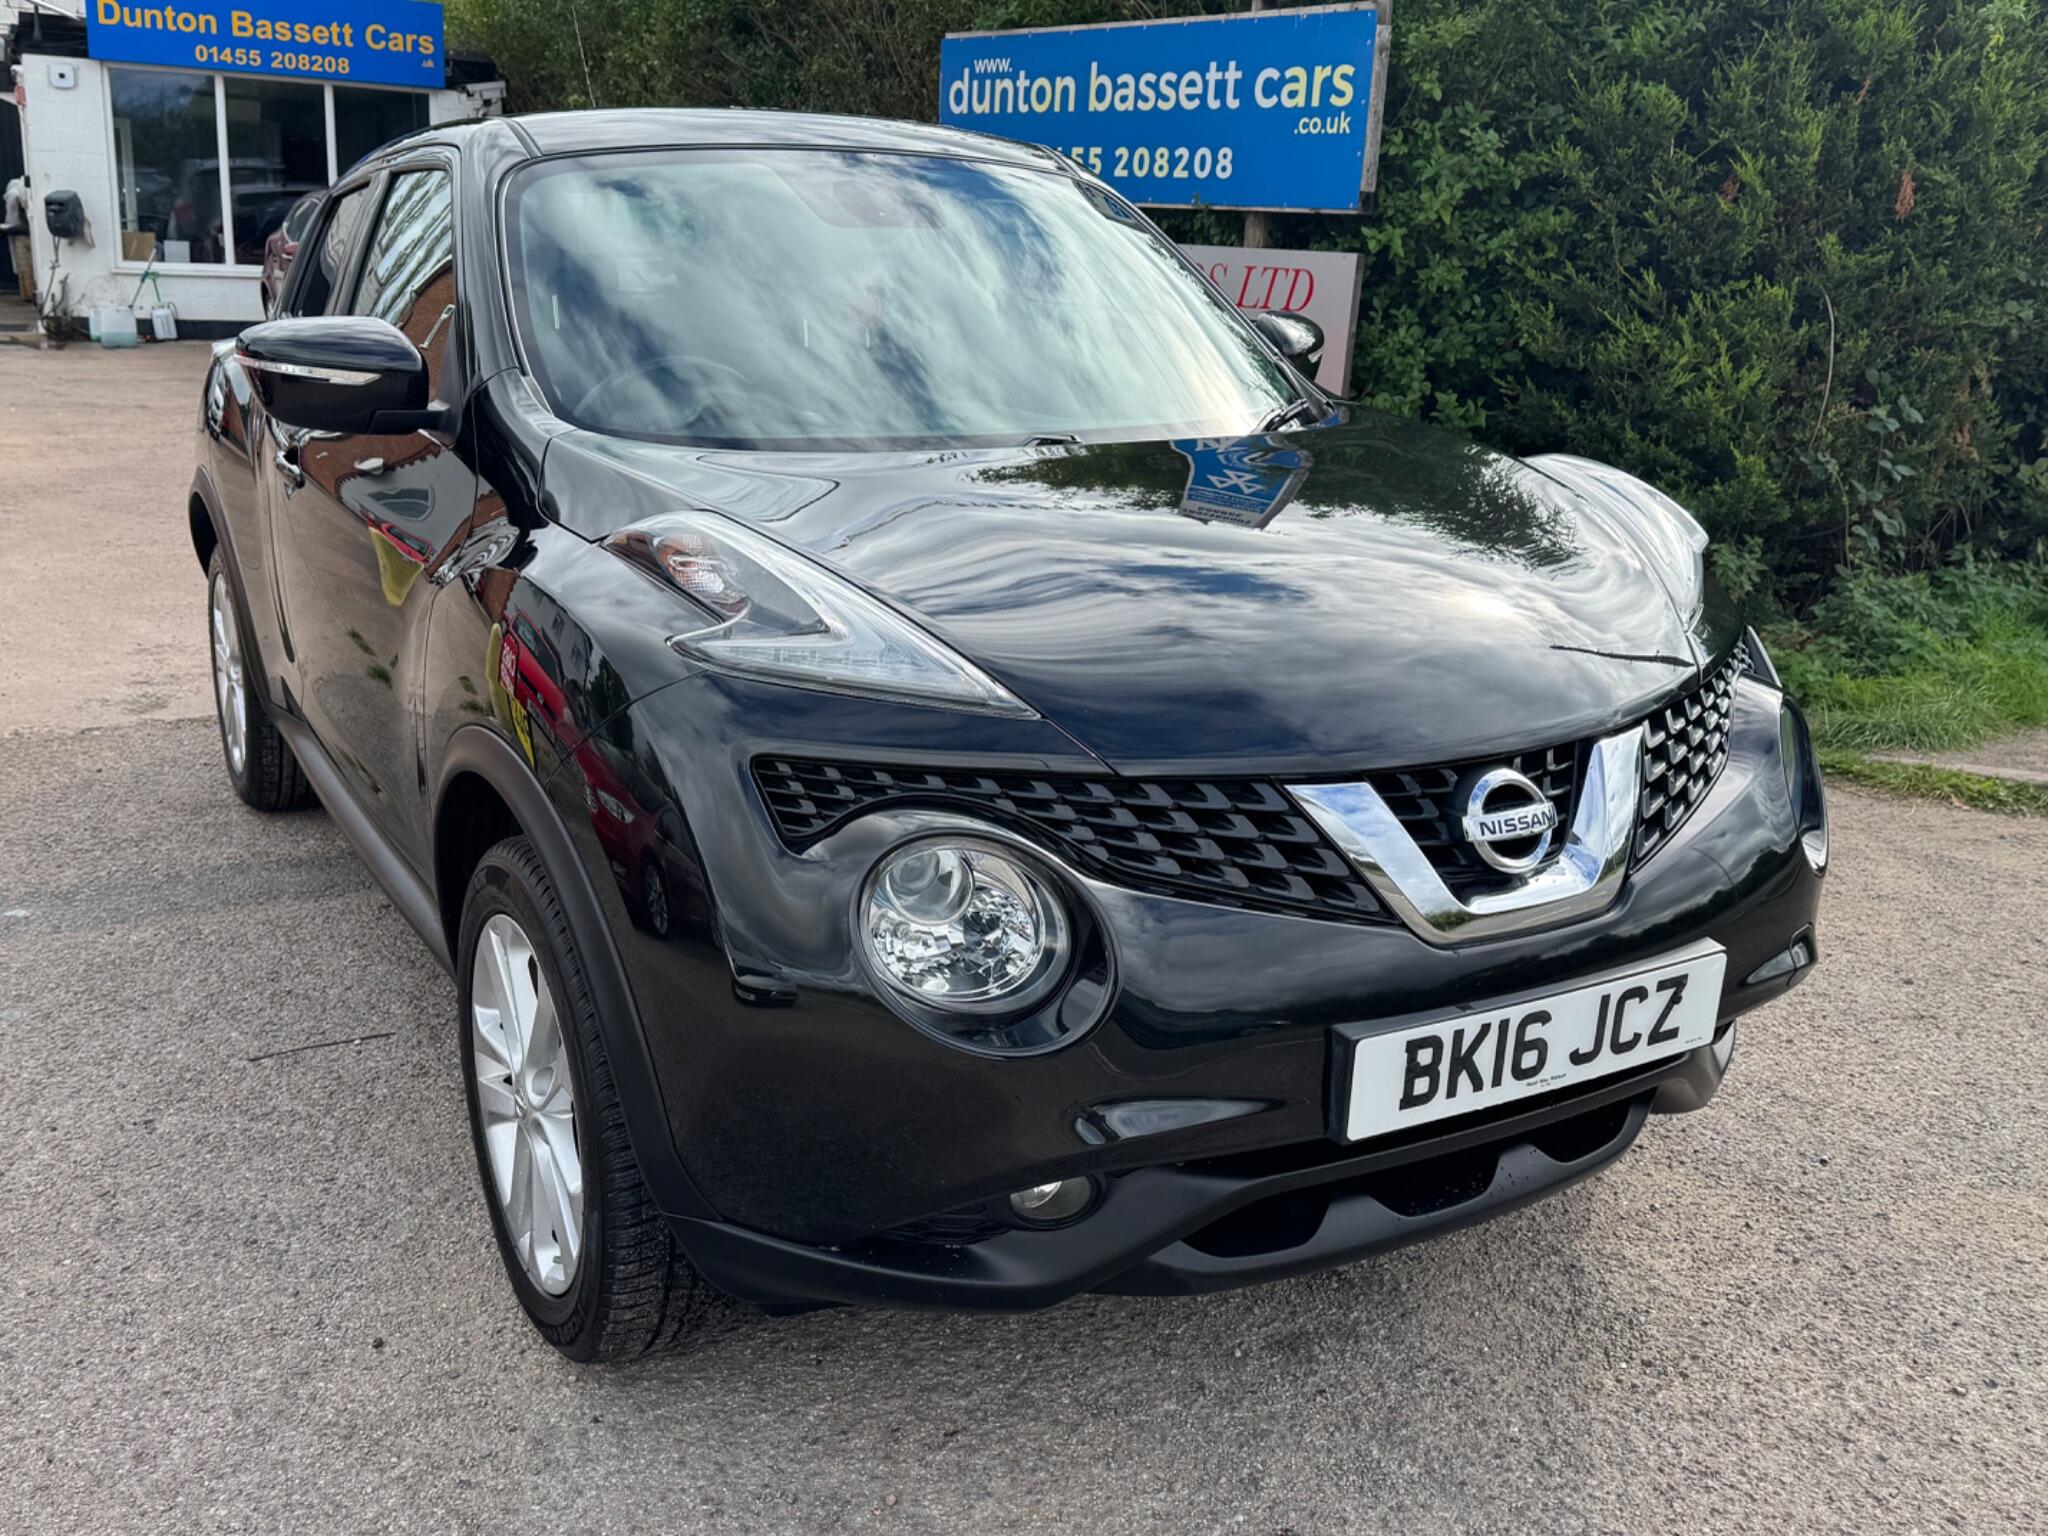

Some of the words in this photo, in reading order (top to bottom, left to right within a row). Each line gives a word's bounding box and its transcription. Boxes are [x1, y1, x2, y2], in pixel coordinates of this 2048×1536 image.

[97, 0, 218, 35] Dunton
[231, 10, 354, 48] Bassett
[365, 23, 435, 55] Cars
[194, 44, 262, 67] 01455
[270, 51, 350, 74] 208208
[974, 57, 1013, 74] www.
[949, 67, 1076, 115] dunton
[1087, 60, 1243, 112] bassett
[1253, 63, 1356, 110] cars
[1293, 110, 1352, 135] .co.uk
[1113, 145, 1233, 180] 208208
[1234, 264, 1316, 313] LTD
[1479, 808, 1554, 837] NISSAN
[1398, 1009, 1553, 1112] BK16
[1568, 972, 1689, 1067] JCZ
